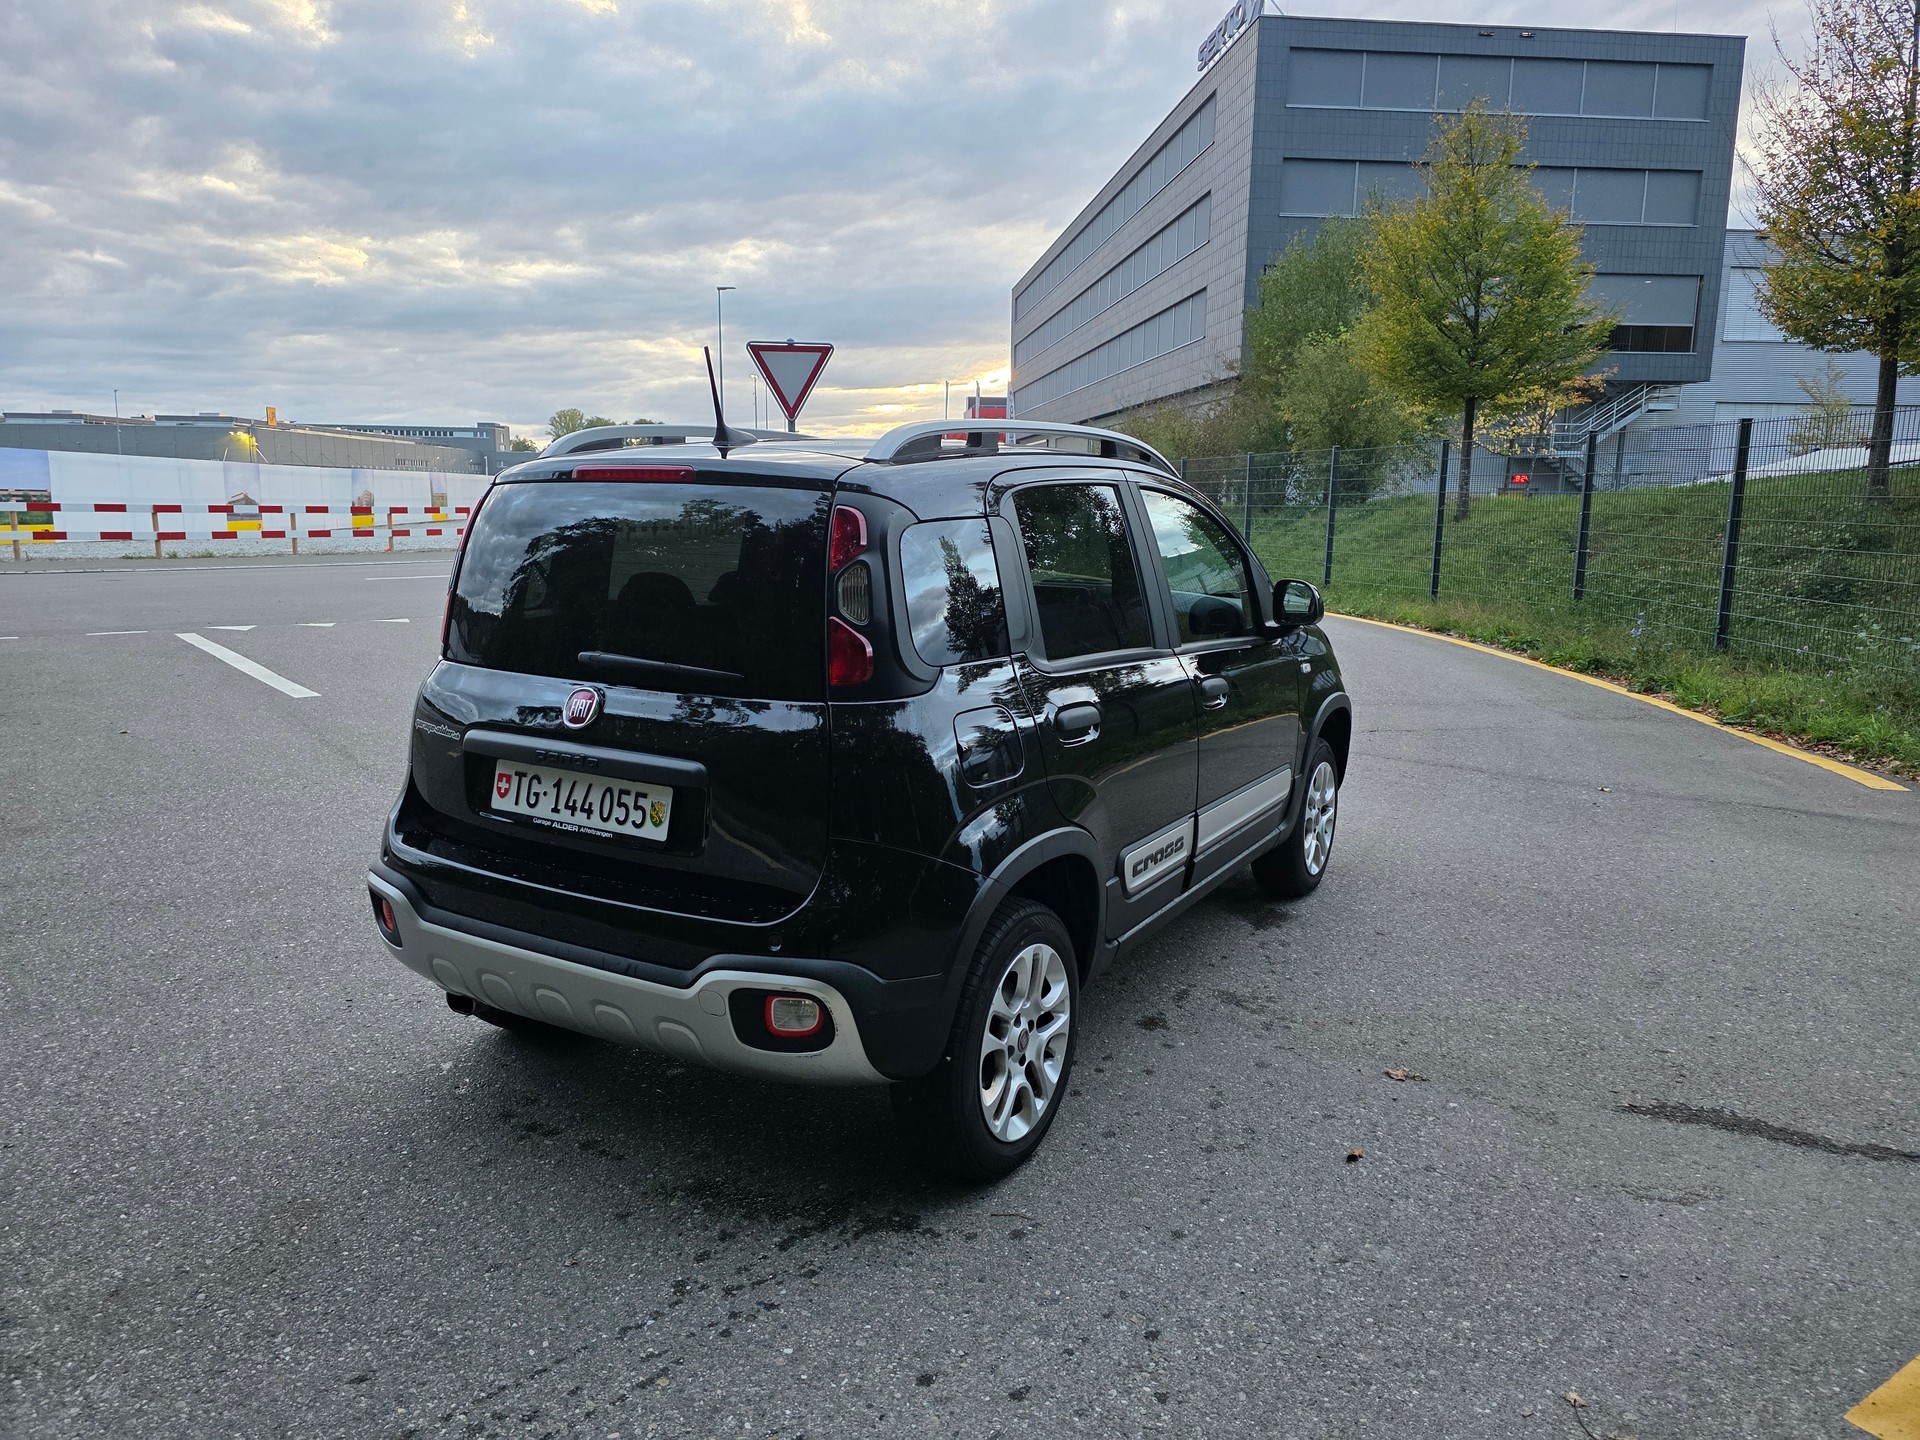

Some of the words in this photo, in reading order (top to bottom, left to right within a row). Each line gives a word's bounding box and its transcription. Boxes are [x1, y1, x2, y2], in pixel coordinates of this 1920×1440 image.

[569, 699, 592, 718] FIAT
[533, 817, 552, 826] Garage
[552, 821, 579, 832] ALDER
[1132, 835, 1184, 878] CROSS
